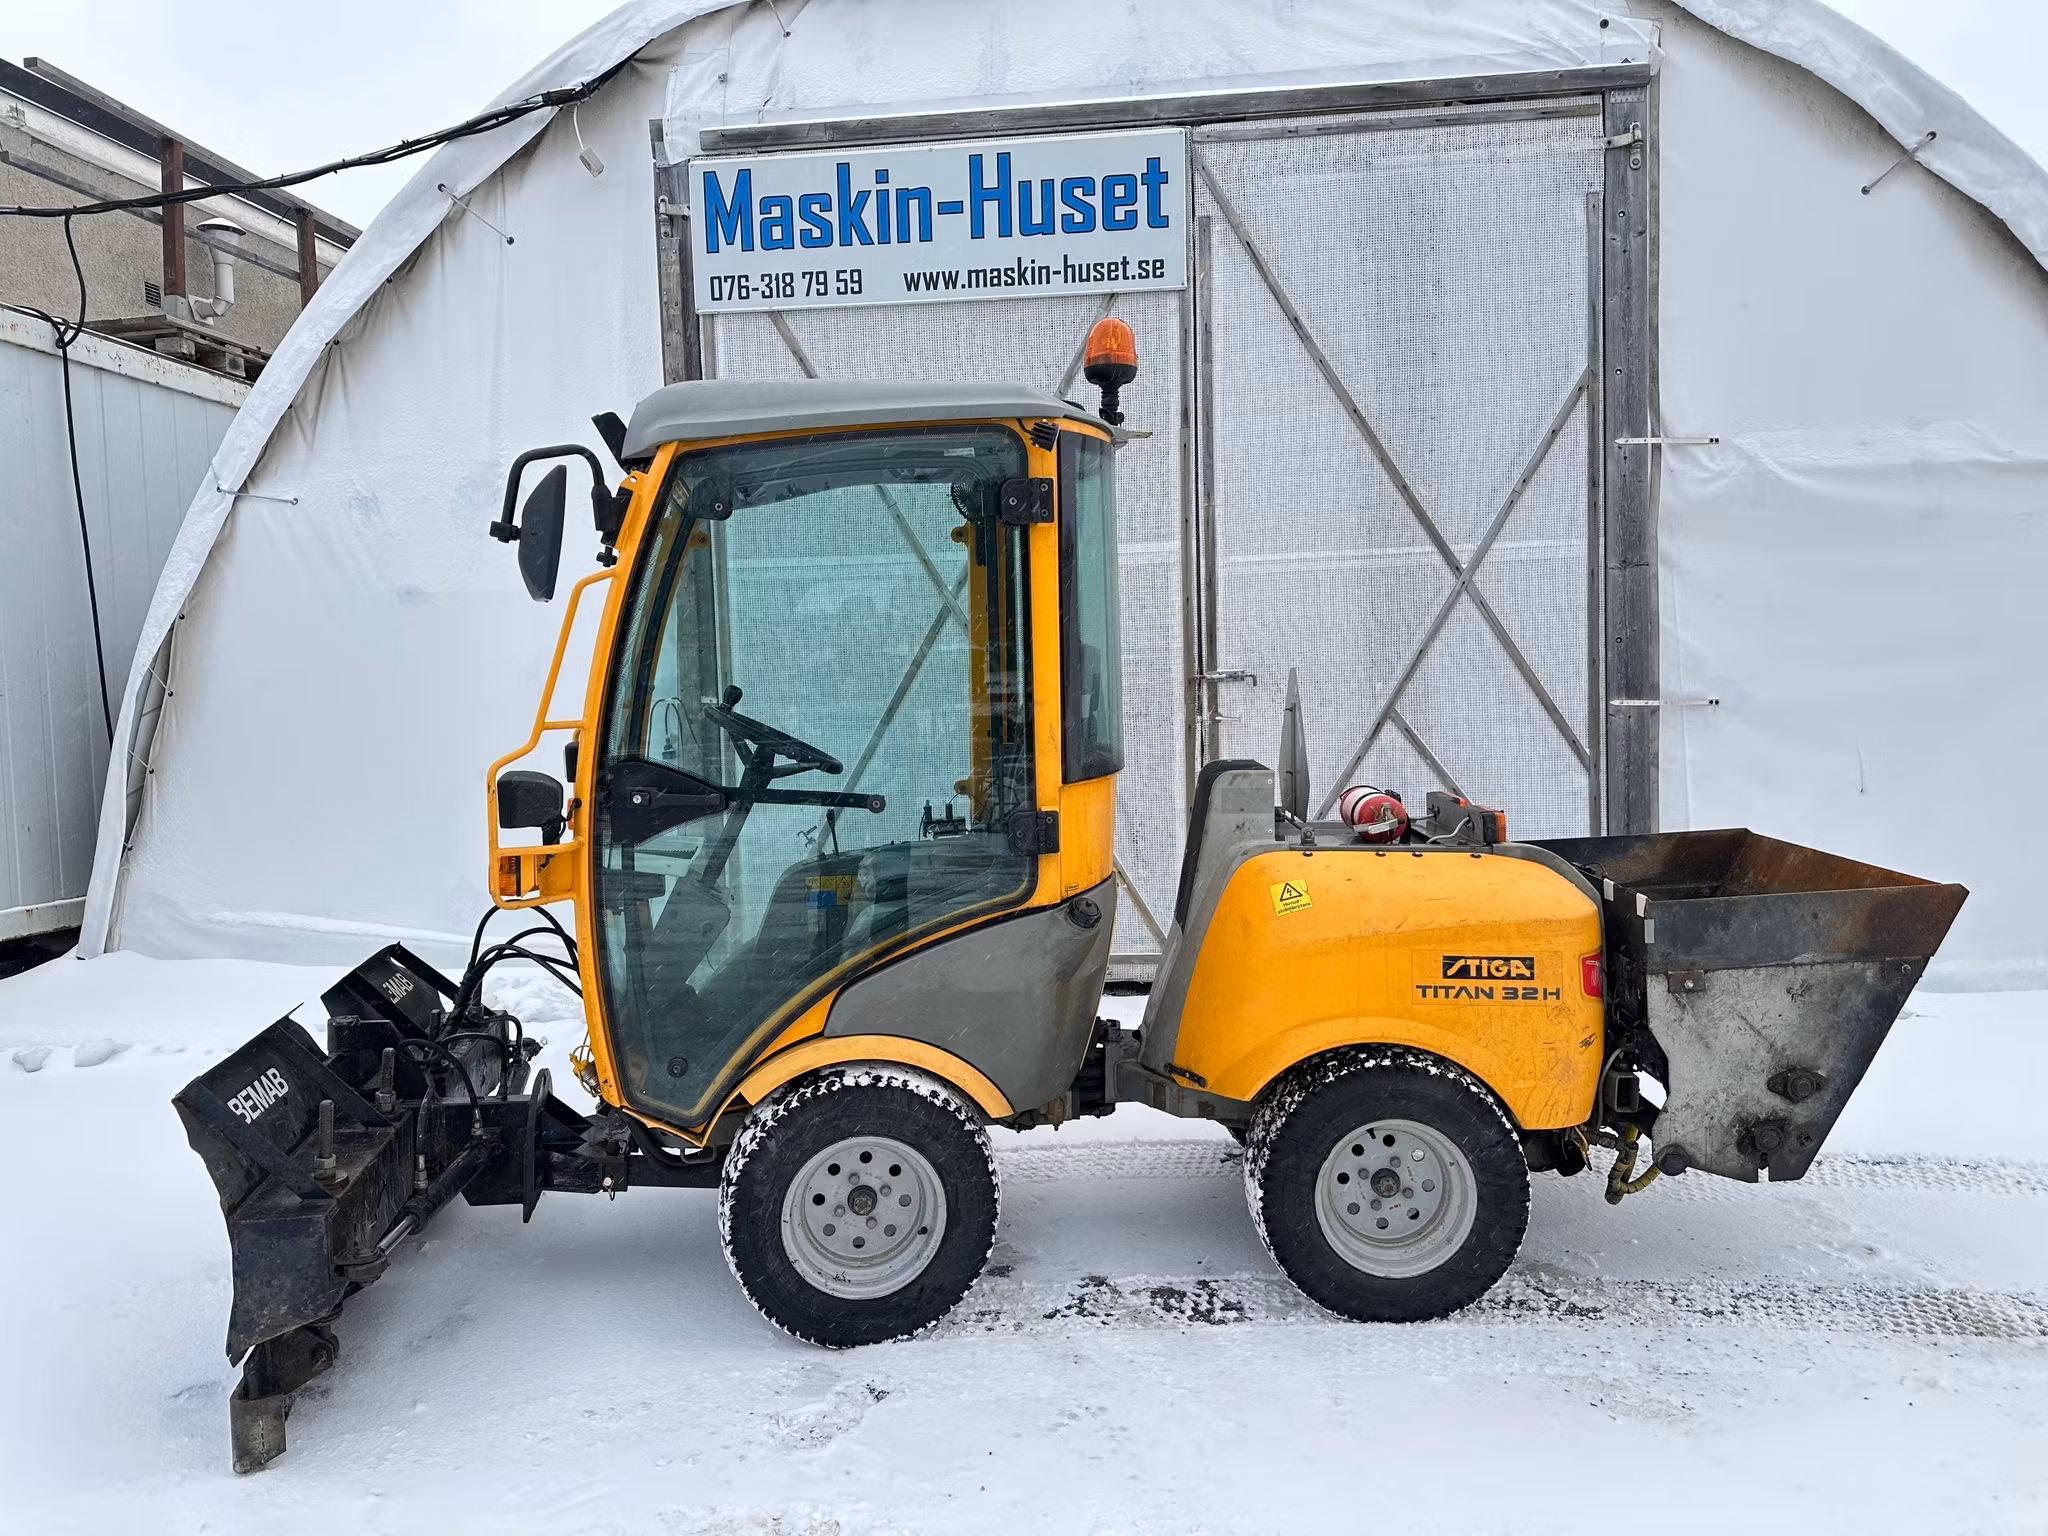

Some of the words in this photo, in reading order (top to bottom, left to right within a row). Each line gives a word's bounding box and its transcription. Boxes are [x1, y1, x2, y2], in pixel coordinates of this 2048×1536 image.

[703, 152, 1169, 254] Maskin-Huset
[710, 272, 795, 301] 076-318
[801, 270, 828, 297] 79
[836, 268, 863, 295] 59
[903, 254, 1165, 292] www.maskin-huset.se
[1446, 958, 1531, 978] STIGA
[1416, 985, 1494, 1000] TITAN
[226, 1067, 289, 1125] BEMAB
